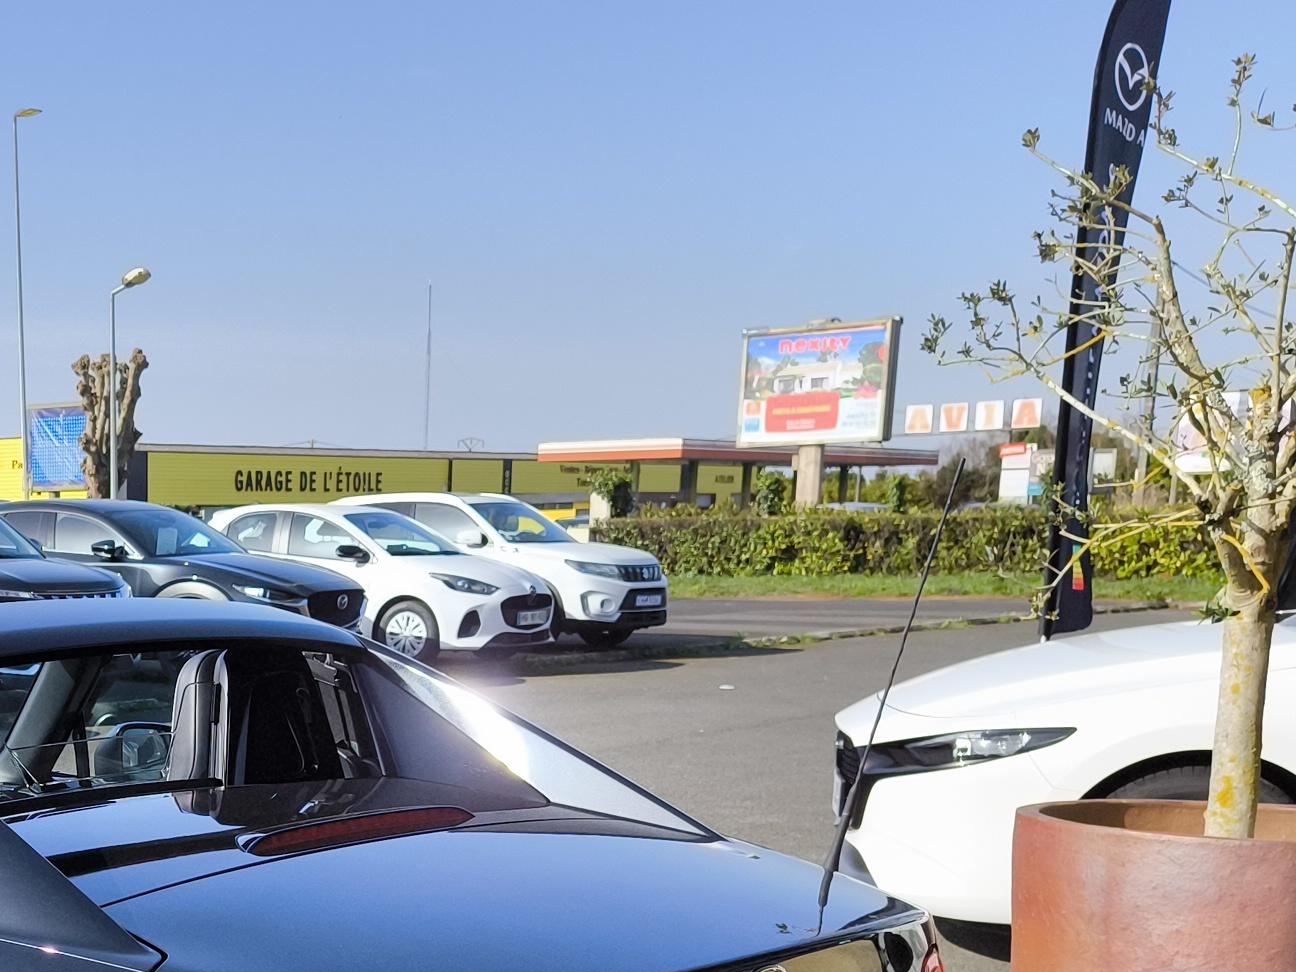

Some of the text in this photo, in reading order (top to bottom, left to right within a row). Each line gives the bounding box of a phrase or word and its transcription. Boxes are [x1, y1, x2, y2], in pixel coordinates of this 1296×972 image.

[1104, 107, 1145, 147] MAZDA
[906, 401, 1039, 432] AVIA
[234, 470, 293, 492] GARAGE
[299, 471, 317, 492] DE
